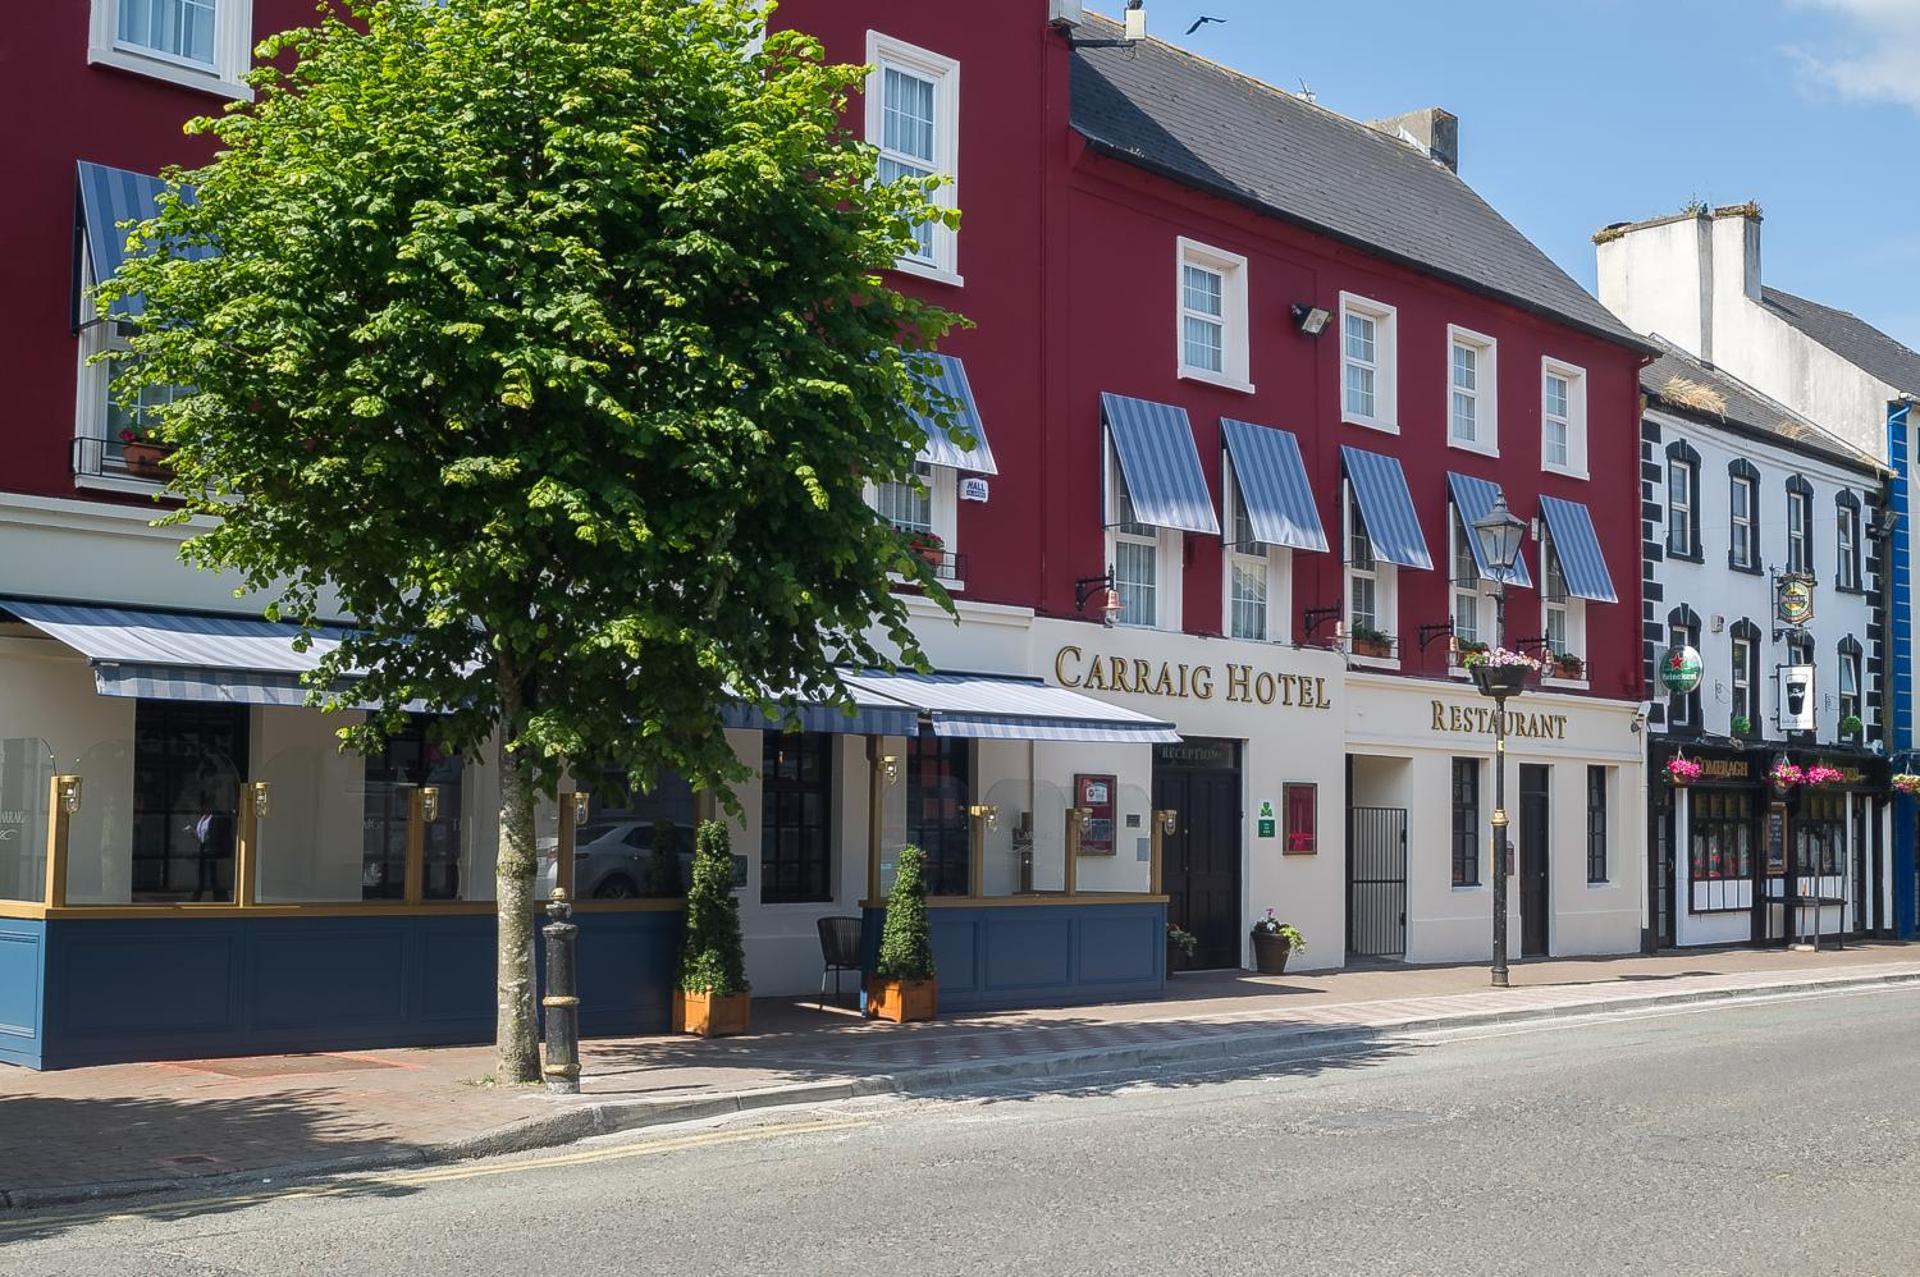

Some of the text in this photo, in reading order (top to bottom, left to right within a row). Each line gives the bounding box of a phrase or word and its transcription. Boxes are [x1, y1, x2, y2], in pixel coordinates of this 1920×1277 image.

[967, 480, 985, 491] HALL
[1055, 645, 1331, 709] CARRAIG HOTEL
[1431, 700, 1567, 739] RESTAURANT
[1161, 743, 1218, 760] RECEPTION
